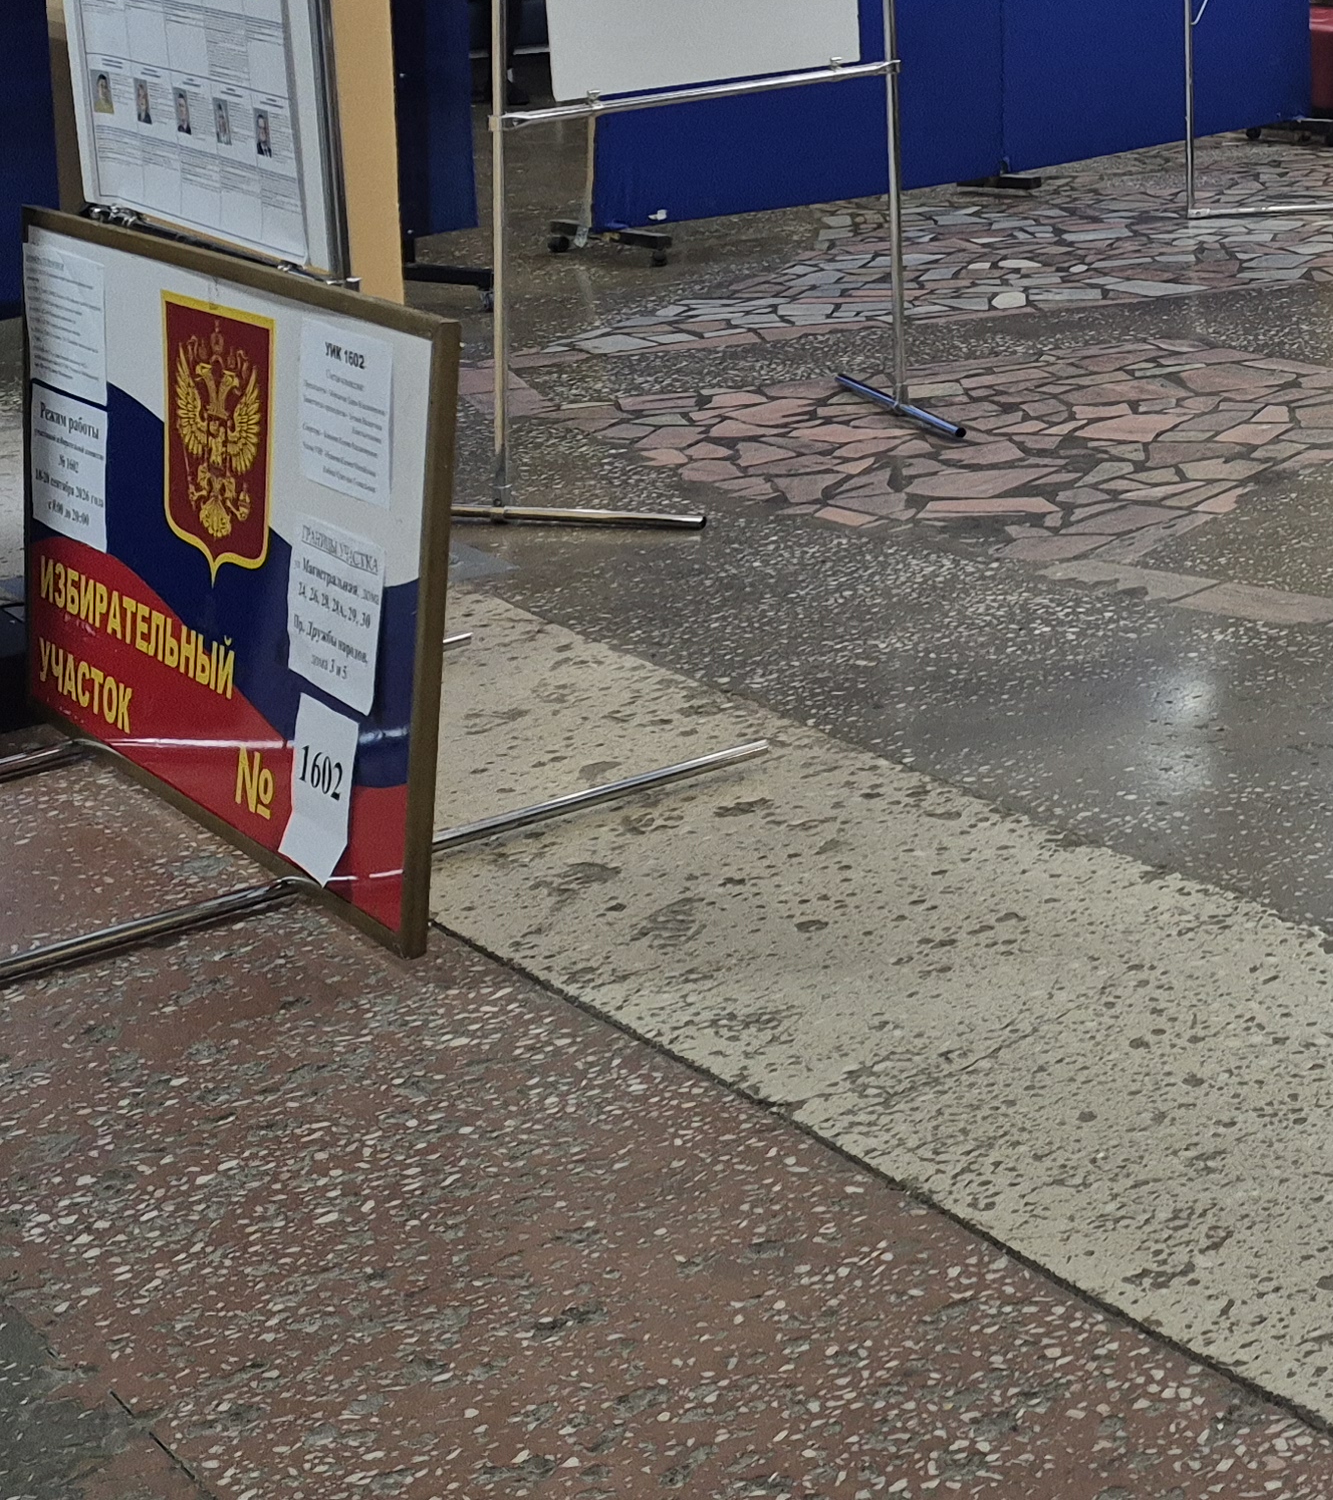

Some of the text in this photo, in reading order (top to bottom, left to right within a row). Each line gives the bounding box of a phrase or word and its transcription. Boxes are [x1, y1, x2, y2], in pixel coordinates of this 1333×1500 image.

[324, 341, 366, 370] УИК 1602
[40, 401, 99, 440] Режим работы
[302, 525, 379, 573] ГРАНИЦЫ УЧАСТКА
[40, 555, 235, 700] ИЗБИРАТЕЛЬНЫЙ
[293, 613, 368, 664] Пр. Дружбы народов,
[360, 612, 371, 629] 30
[38, 637, 133, 734] УЧАСТОК
[329, 658, 334, 673] 3
[342, 664, 348, 679] 5
[235, 745, 343, 820] № 1602
